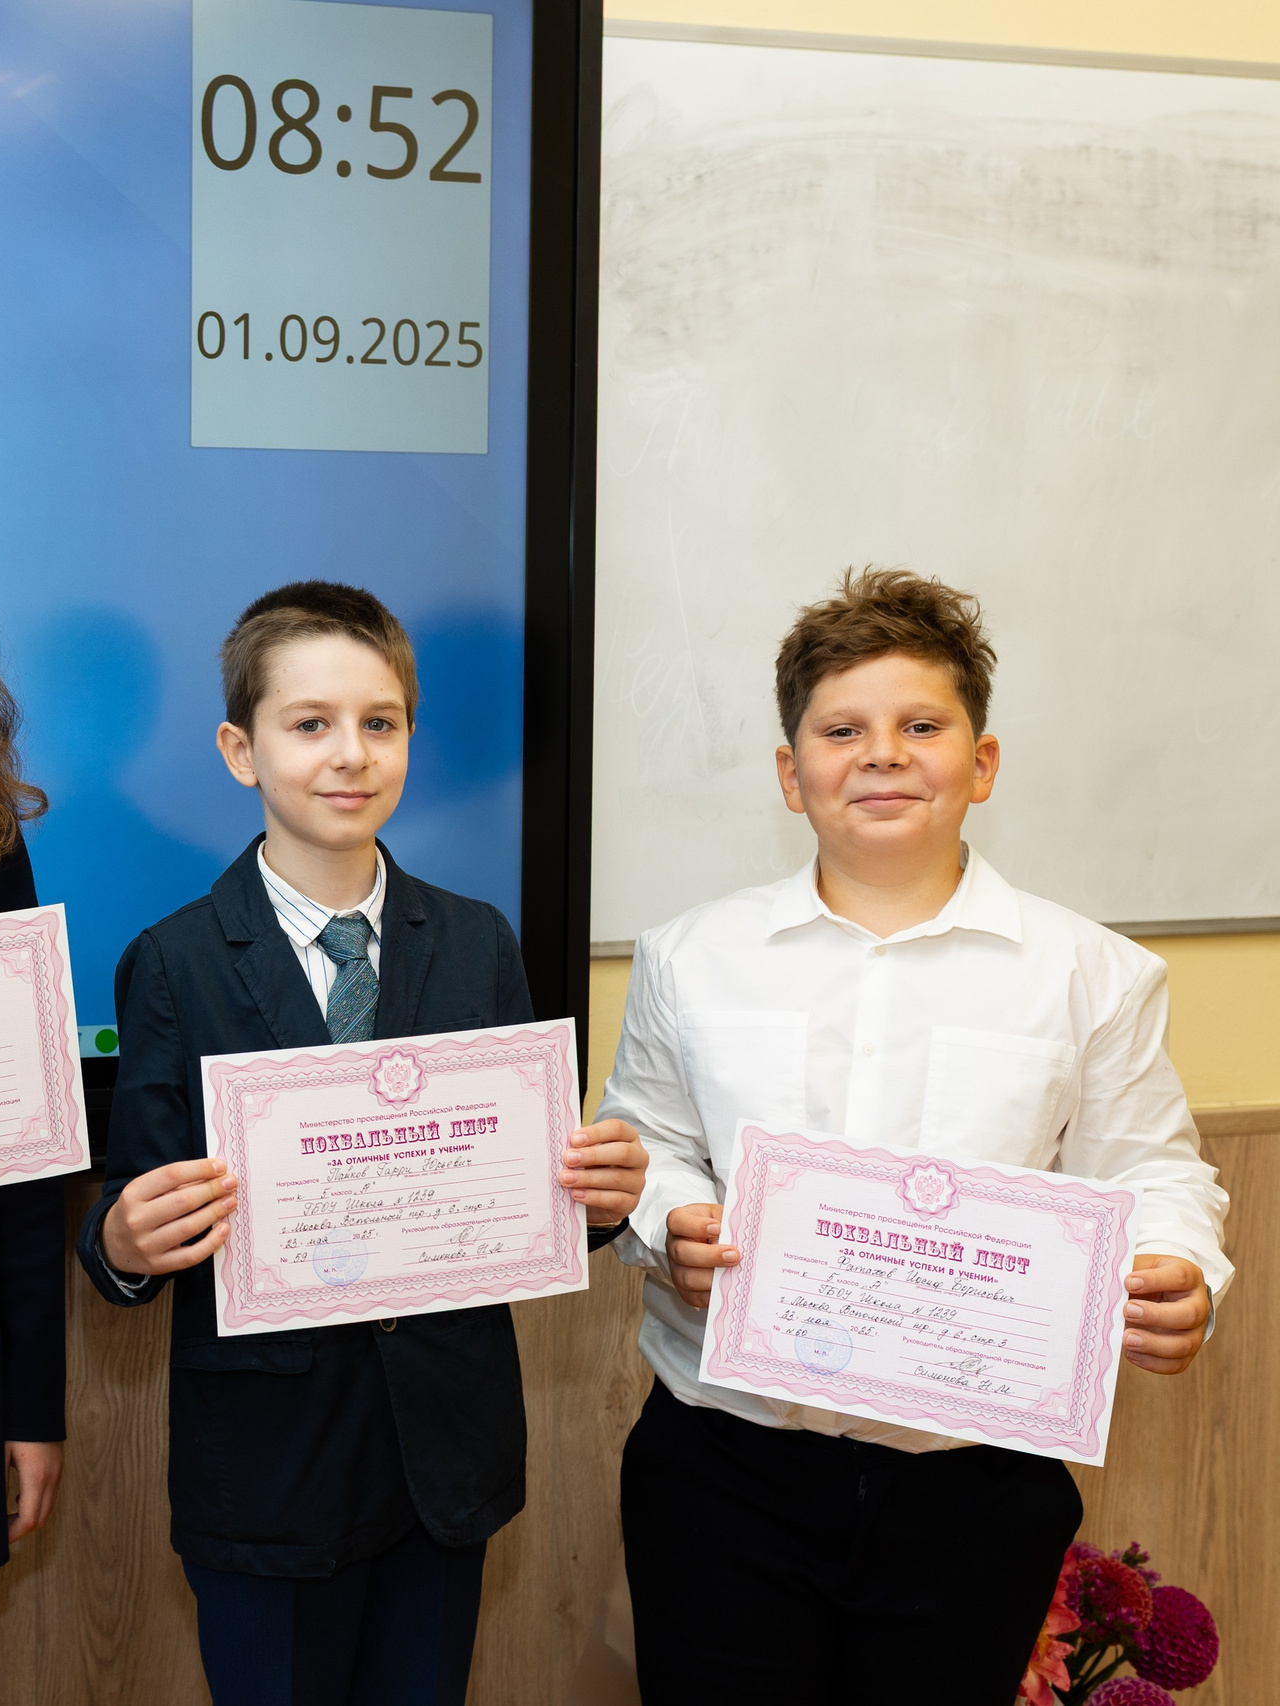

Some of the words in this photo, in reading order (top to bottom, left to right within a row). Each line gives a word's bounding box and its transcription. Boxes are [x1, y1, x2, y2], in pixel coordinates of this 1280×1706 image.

[200, 74, 482, 184] 08:52
[196, 311, 483, 368] 01.09.2025
[299, 1118, 355, 1129] Министерство
[356, 1112, 407, 1124] просвещения
[410, 1106, 453, 1118] Российской
[455, 1101, 497, 1111] Федерации
[300, 1120, 440, 1155] ПОХВАЛЬНЫЙ
[448, 1116, 498, 1138] ЛИСТ
[346, 1153, 390, 1166] ОТЛИЧНЫЕ
[394, 1150, 427, 1160] УСПЕХИ
[439, 1144, 474, 1154] УЧЕНИИ»
[276, 1178, 320, 1188] Награждается
[303, 1201, 337, 1216] ГБОУ
[346, 1198, 384, 1210] Школа
[408, 1190, 435, 1202] 1239
[402, 1225, 440, 1234] Руководитель
[441, 1218, 491, 1230] образовательной
[493, 1213, 529, 1223] организации
[819, 1203, 876, 1220] Министерство
[878, 1214, 932, 1231] просвещения
[934, 1224, 982, 1241] Российской
[984, 1234, 1032, 1250] Федерации
[814, 1218, 964, 1262] ПОХВАЛЬНЫЙ
[972, 1249, 1031, 1275] ЛИСТ
[784, 1252, 828, 1266] Награждается
[952, 1276, 1015, 1303] Борисович
[836, 1278, 859, 1287] класса
[859, 1251, 905, 1266] ОТЛИЧНЫЕ
[910, 1260, 945, 1274] УСПЕХИ
[958, 1270, 998, 1284] УЧЕНИИ»
[818, 1284, 852, 1300] ГБОУ
[860, 1293, 901, 1311] Школа
[929, 1307, 957, 1320] 1239
[902, 1336, 944, 1350] Руководитель
[945, 1345, 1002, 1362] образовательной
[1003, 1356, 1046, 1371] организации
